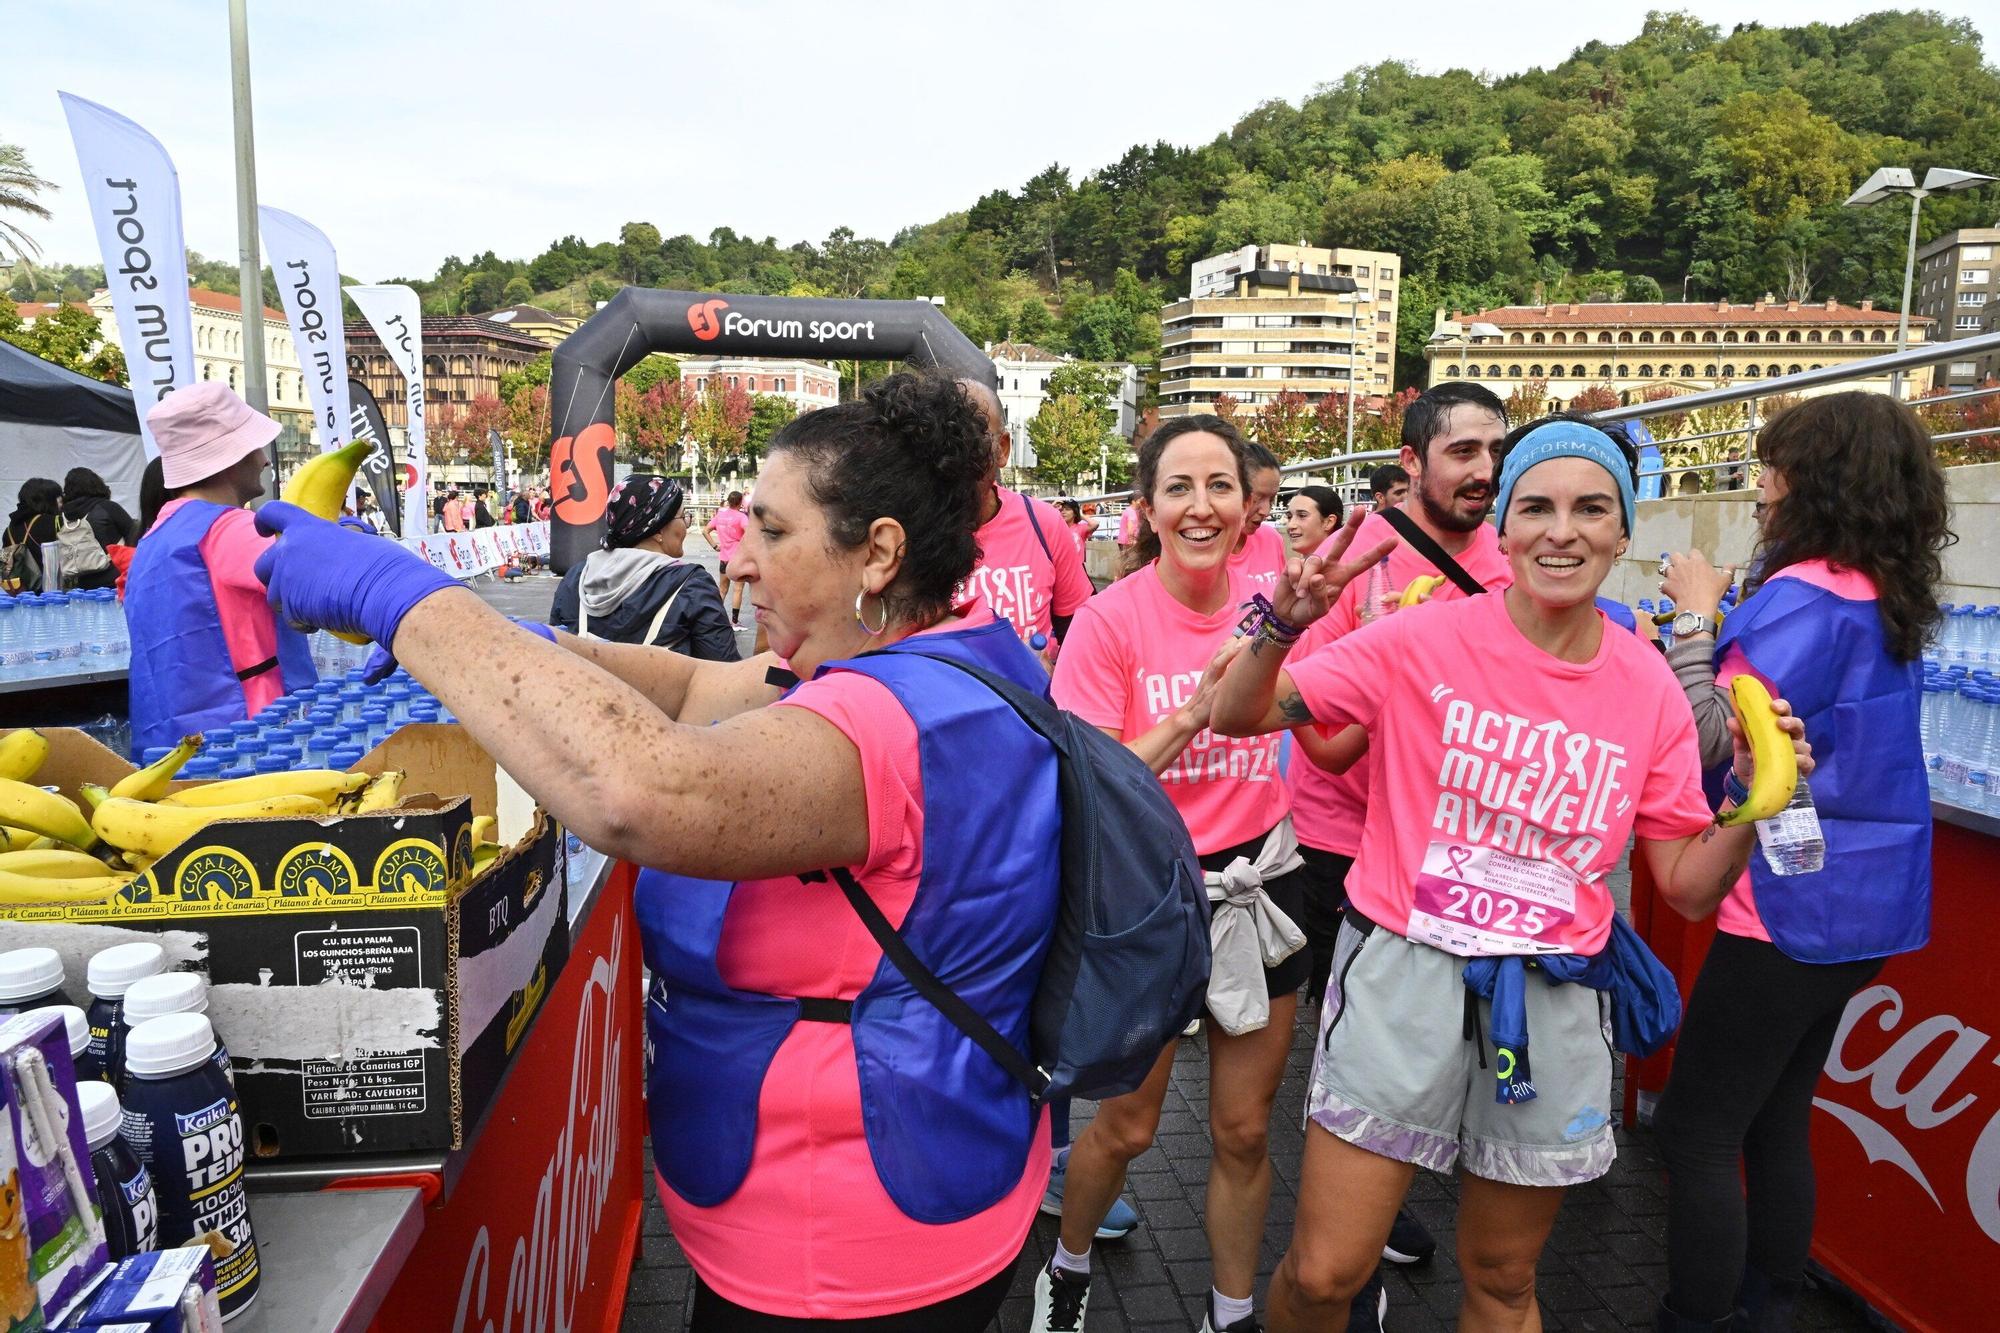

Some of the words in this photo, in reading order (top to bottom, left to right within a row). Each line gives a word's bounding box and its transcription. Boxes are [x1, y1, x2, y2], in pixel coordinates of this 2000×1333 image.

[724, 311, 803, 340] Forum
[809, 320, 875, 342] sport
[1432, 792, 1603, 872] AVANZA
[283, 853, 349, 890] COPALMA
[380, 849, 445, 886] COPALMA
[183, 857, 250, 894] COPALMA
[273, 897, 310, 908] Plátanos
[312, 897, 323, 906] de
[324, 895, 363, 905] Canarias
[370, 894, 407, 904] Plátanos
[408, 893, 419, 902] de
[70, 907, 109, 917] Plátanos
[111, 906, 122, 915] de
[124, 903, 165, 914] Canarias
[173, 902, 211, 912] Plátanos
[213, 901, 223, 910] de
[226, 900, 265, 910] Canarias
[1442, 885, 1547, 935] 2025
[20, 908, 62, 918] Canarias
[489, 895, 510, 936] BTQ
[341, 937, 352, 945] DE
[353, 937, 364, 945] LA
[364, 936, 394, 944] PALMA
[303, 950, 319, 958] LOS
[319, 946, 392, 957] GUINCHOS-BREÑA
[392, 946, 414, 954] BAJA
[354, 957, 365, 965] LA
[366, 956, 395, 964] PALMA
[326, 968, 349, 976] ISAS
[91, 1027, 109, 1038] SIN
[345, 1063, 358, 1072] de
[360, 1061, 401, 1071] Canarias
[403, 1059, 420, 1069] IGP
[307, 1079, 329, 1087] Peso
[362, 1076, 373, 1084] 16
[376, 1075, 396, 1084] kgs.
[365, 1087, 418, 1098] CAVENDISH
[311, 1106, 336, 1115] CALIBRE
[398, 1102, 406, 1110] 14
[184, 1105, 227, 1133] Kaiku
[182, 1112, 243, 1172] PRO
[186, 1143, 245, 1190] TEIN
[191, 1181, 243, 1215] 100%
[199, 1196, 246, 1234] WHEY
